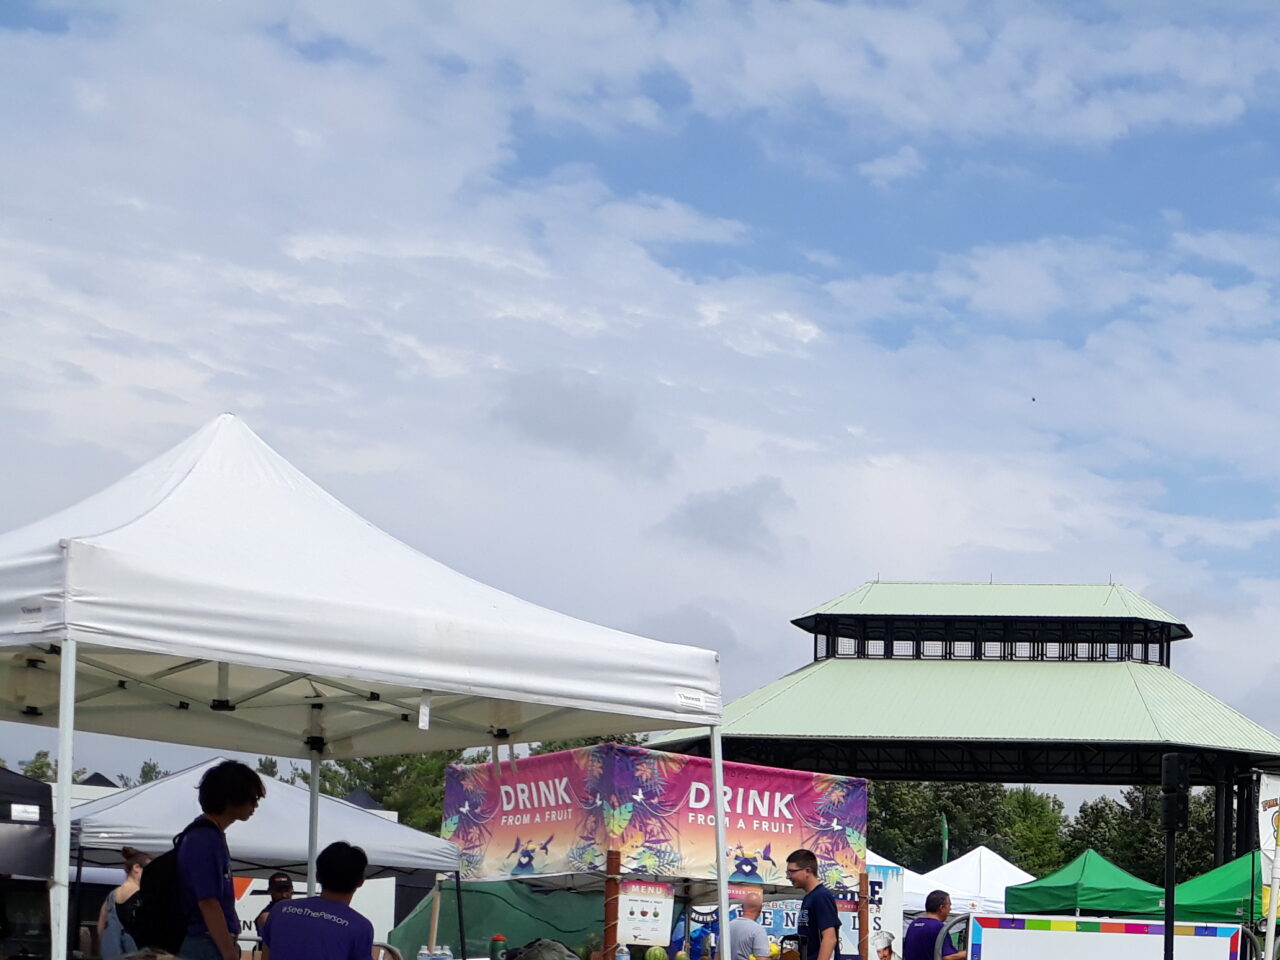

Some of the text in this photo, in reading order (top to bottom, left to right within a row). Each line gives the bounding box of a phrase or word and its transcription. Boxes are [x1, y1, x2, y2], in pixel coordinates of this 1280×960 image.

[500, 776, 571, 812] DRINK
[688, 781, 795, 820] DRINK
[501, 808, 573, 826] FROM A FRUIT
[737, 818, 746, 830] A
[753, 819, 794, 834] FRUIT
[631, 884, 662, 895] MENU
[282, 905, 349, 927] #SeeThePerson
